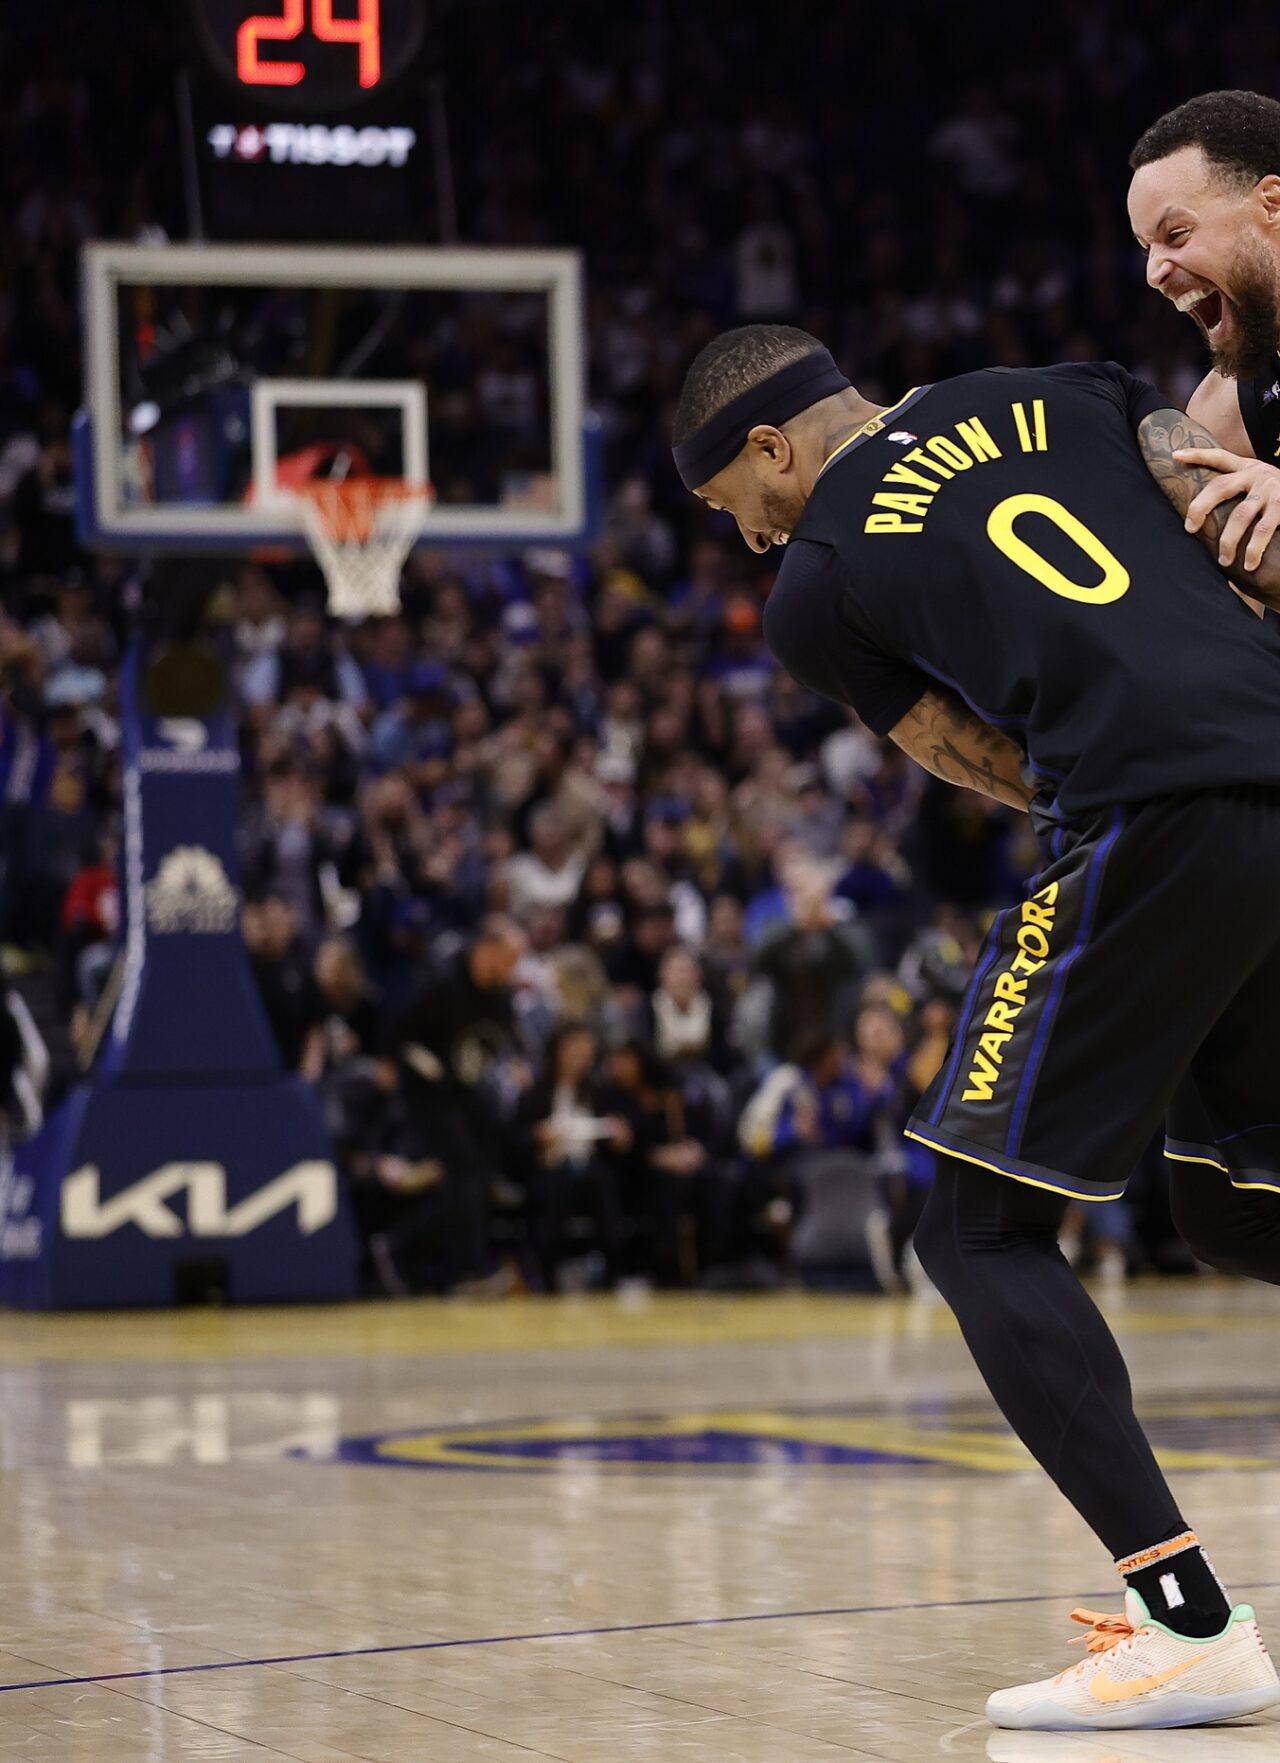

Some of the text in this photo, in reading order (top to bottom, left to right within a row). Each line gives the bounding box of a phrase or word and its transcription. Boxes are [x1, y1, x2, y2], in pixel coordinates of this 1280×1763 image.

[237, 0, 381, 88] 24
[864, 399, 1048, 534] PAYTON II
[987, 493, 1131, 605] 0
[961, 881, 1060, 1102] WARRIORS
[60, 1160, 338, 1238] KIA
